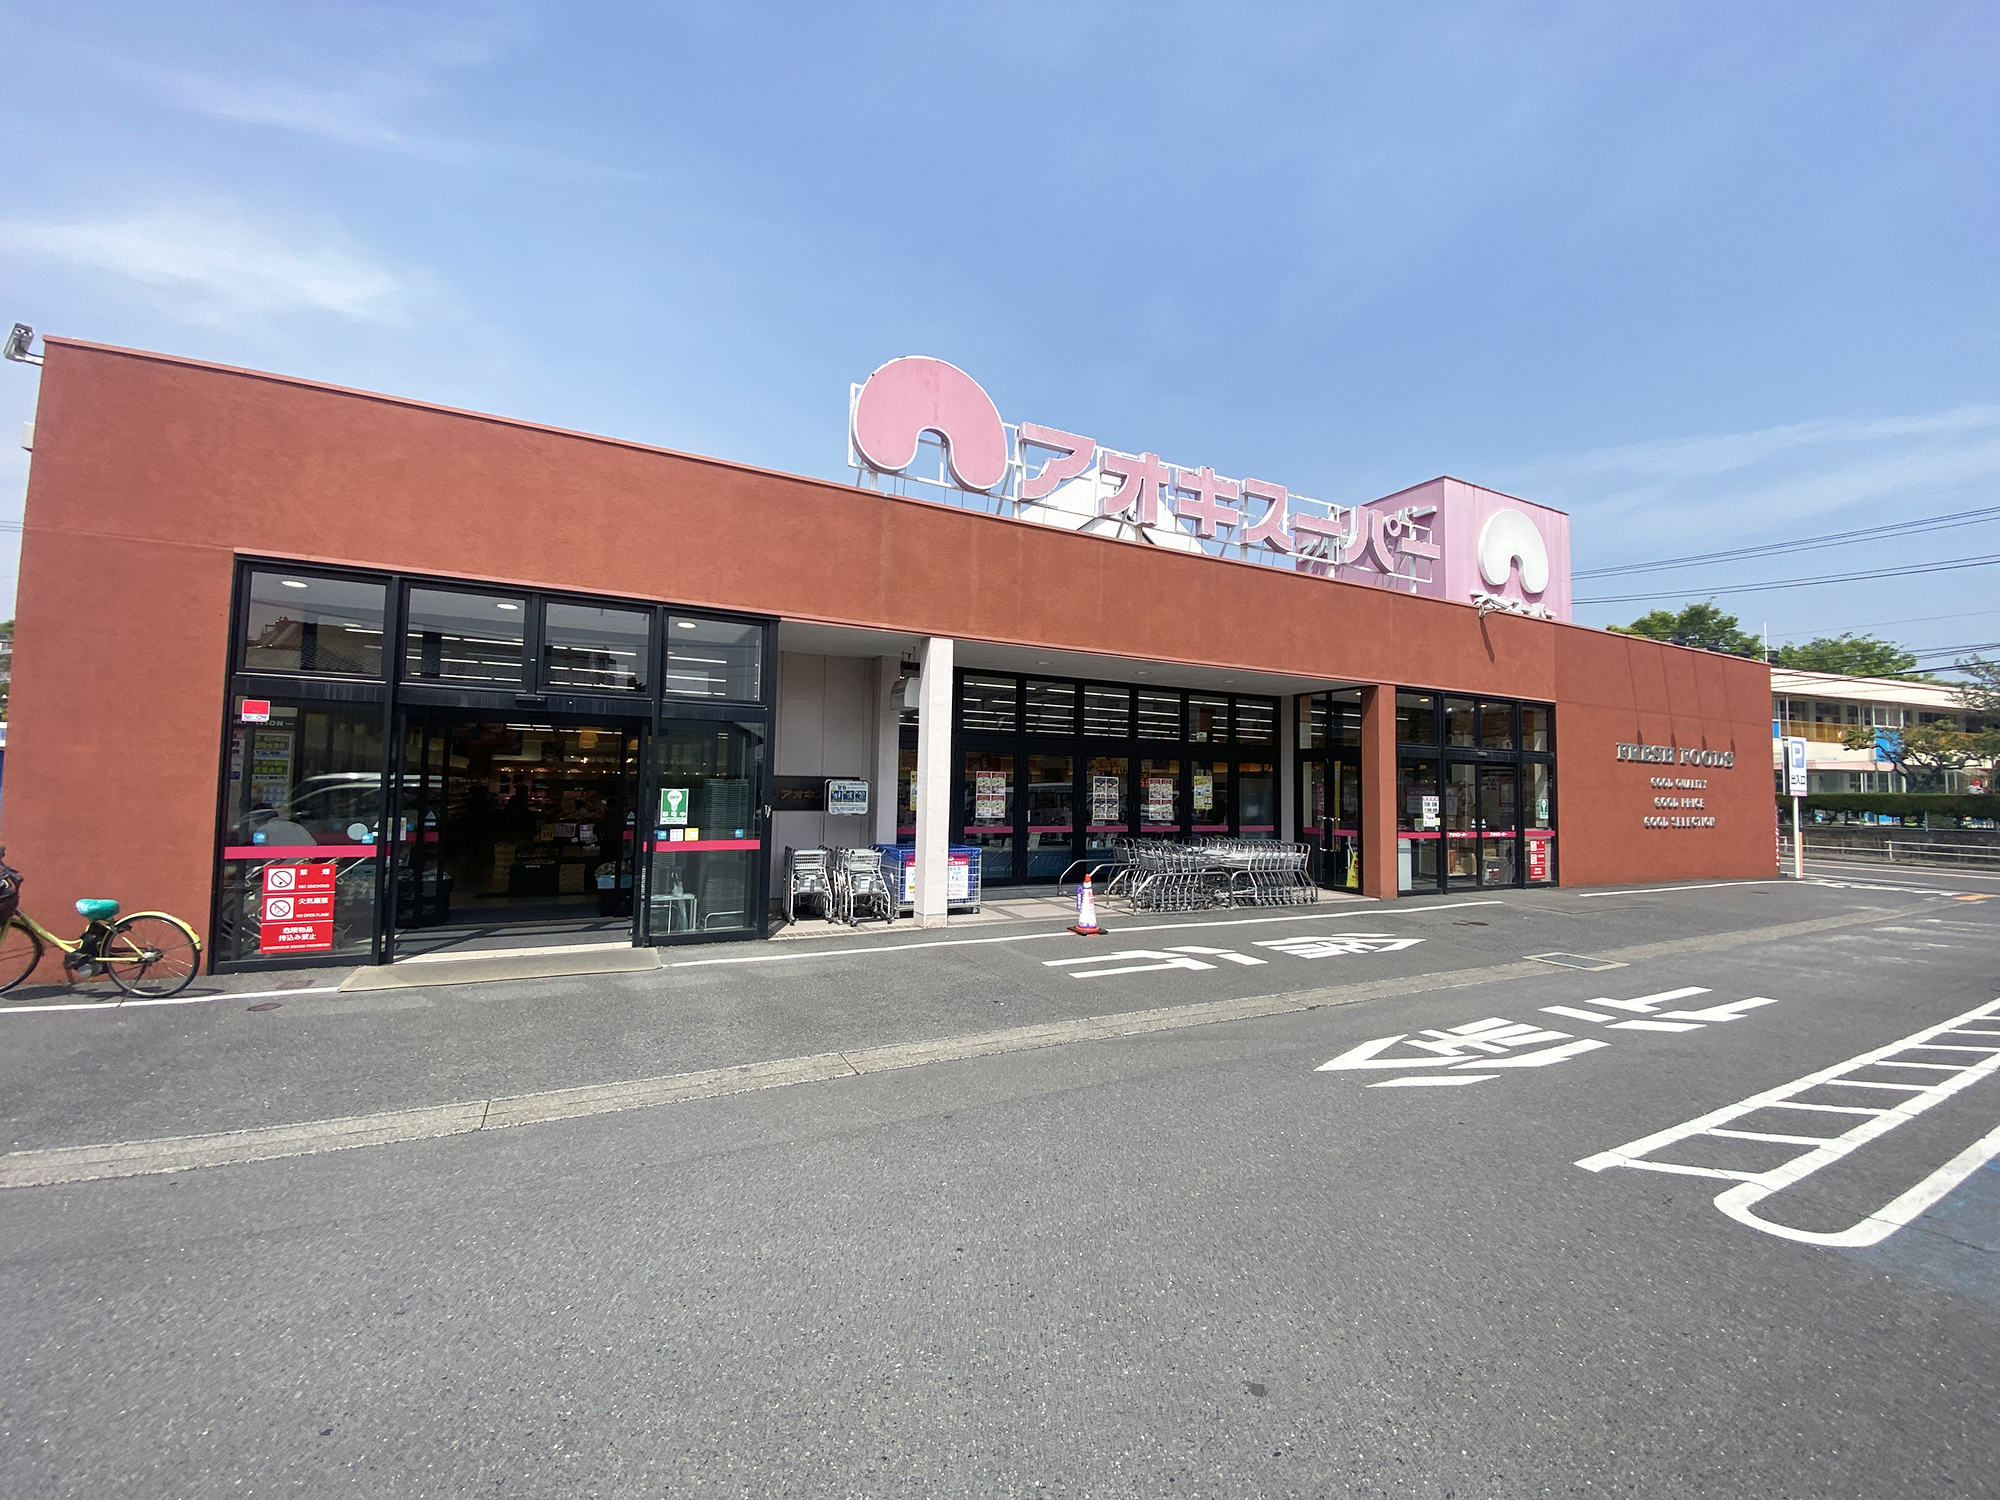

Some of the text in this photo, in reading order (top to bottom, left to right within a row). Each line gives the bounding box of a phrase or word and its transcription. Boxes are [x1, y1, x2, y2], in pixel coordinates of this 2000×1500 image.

[1018, 421, 1441, 575] アオキスーパー
[1616, 743, 1735, 768] FRESH FOODS
[1650, 777, 1708, 789] GOOD QUALITY
[1654, 797, 1706, 809] GOOD PRICE
[1643, 816, 1716, 828] GOOD SELECTION
[278, 933, 316, 942] 持込み禁止
